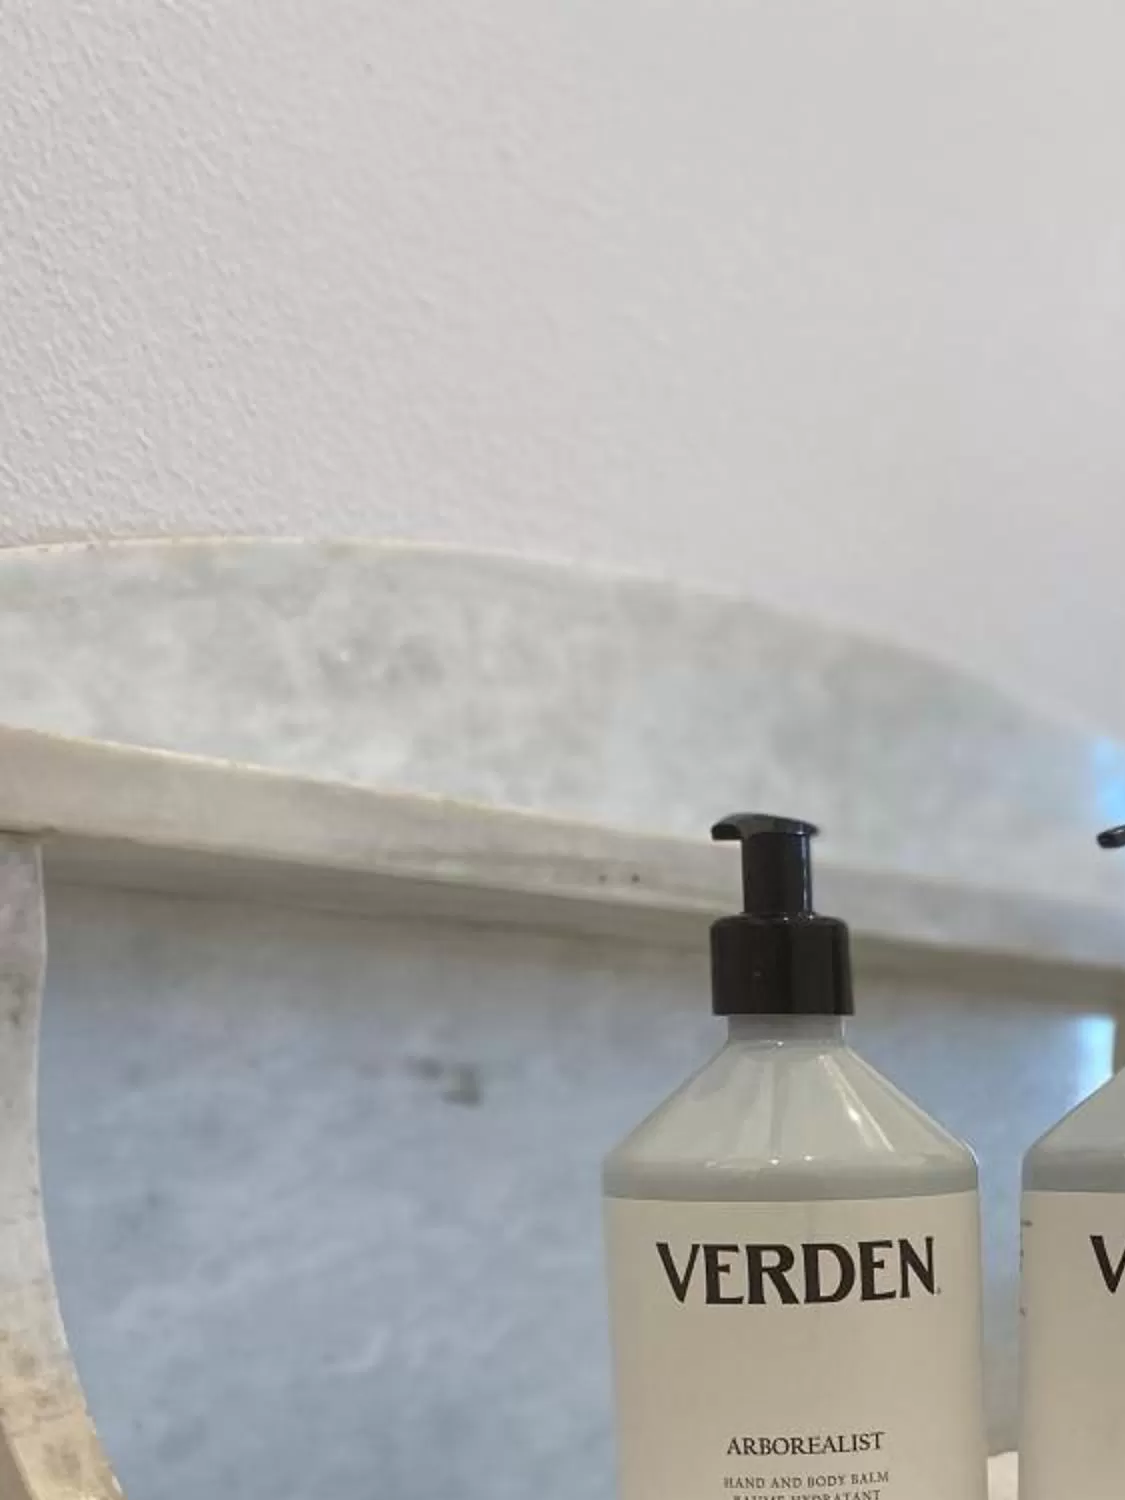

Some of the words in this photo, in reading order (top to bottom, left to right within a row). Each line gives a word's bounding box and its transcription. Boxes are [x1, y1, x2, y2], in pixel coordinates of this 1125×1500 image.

[655, 1236, 936, 1304] VERDEN
[726, 1431, 885, 1456] ARBOREALIST
[723, 1476, 765, 1489] HAND
[770, 1476, 802, 1489] AND
[807, 1474, 845, 1488] BODY
[850, 1471, 889, 1485] BALM
